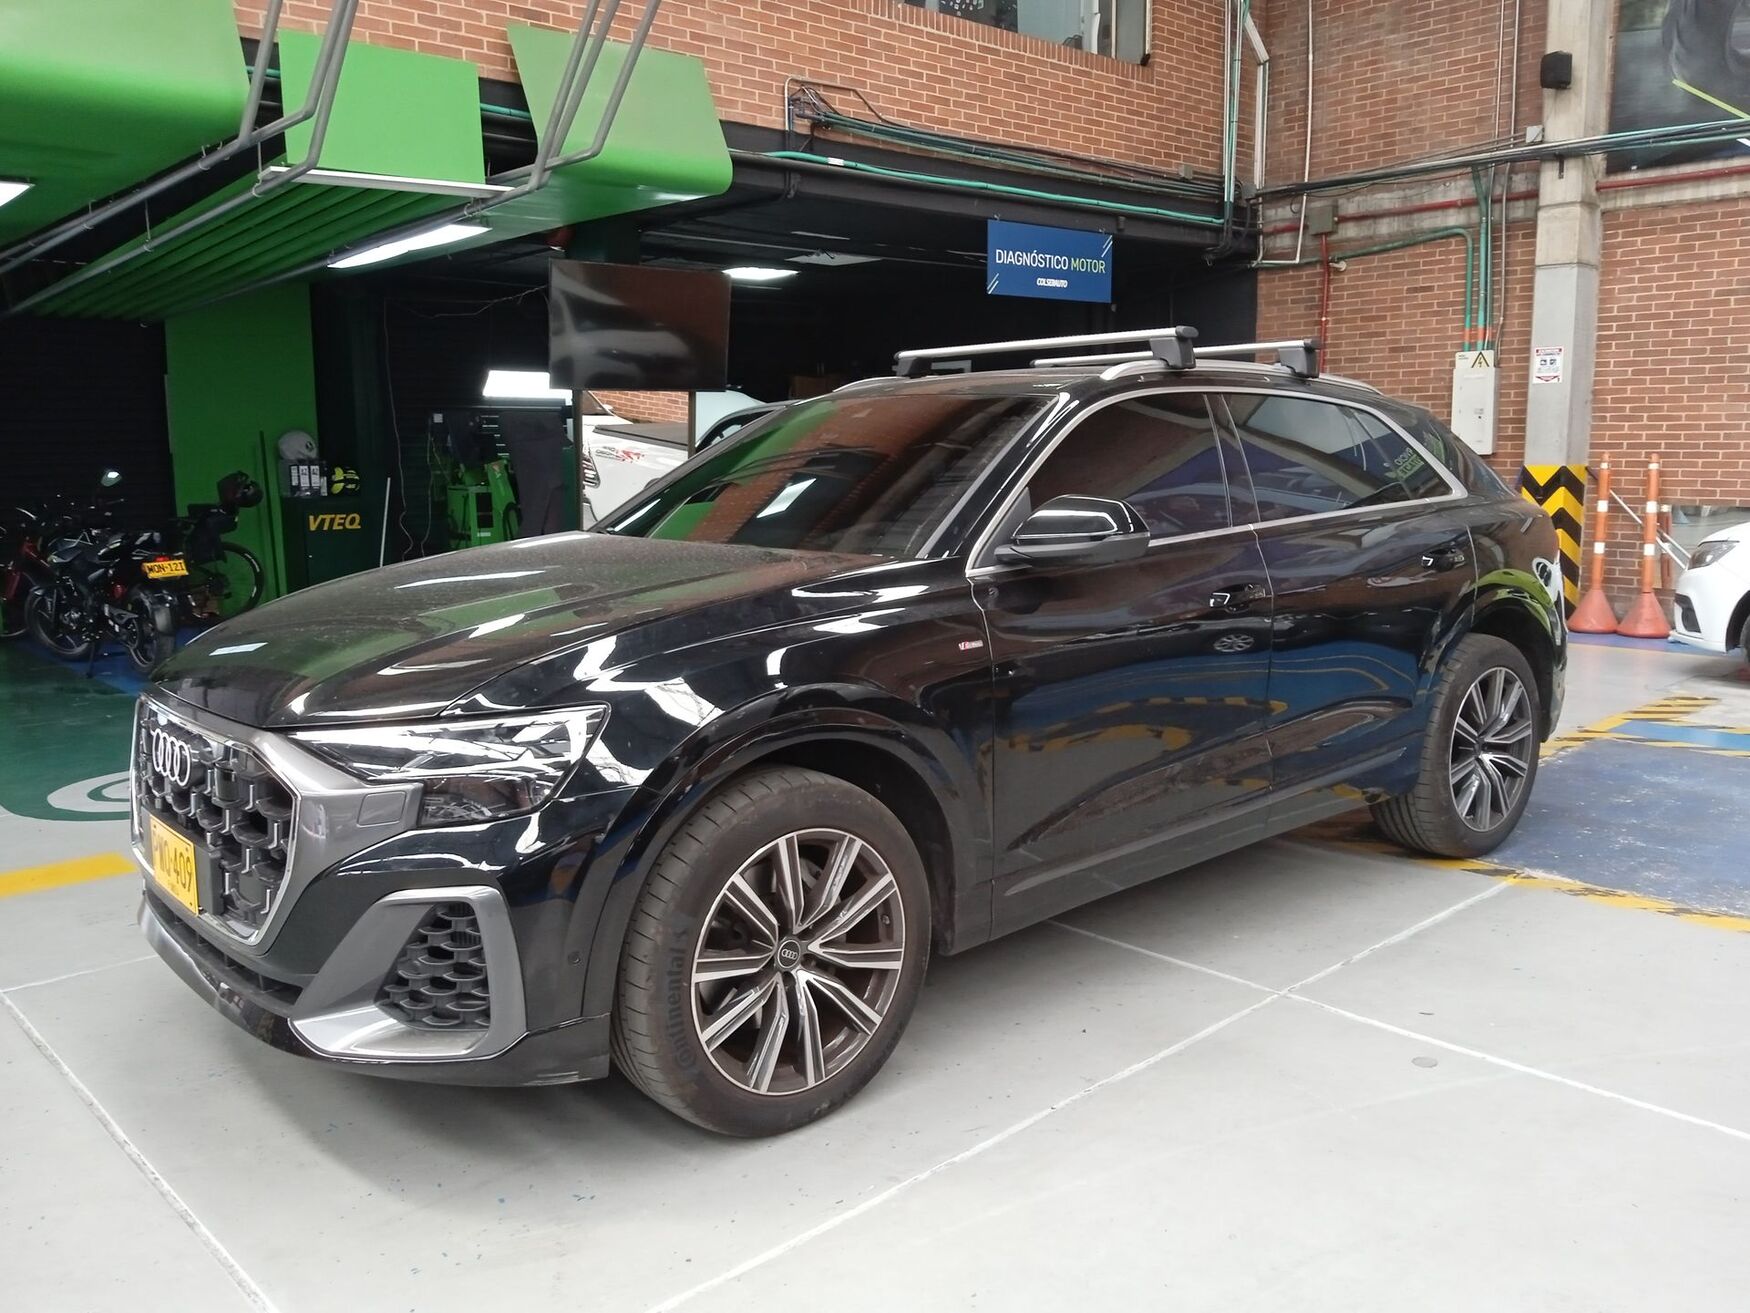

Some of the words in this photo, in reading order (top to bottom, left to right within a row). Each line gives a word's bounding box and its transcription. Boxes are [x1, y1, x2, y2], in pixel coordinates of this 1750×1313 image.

[995, 249, 1069, 270] DIAGNÓSTICO
[1071, 258, 1106, 274] MOTOR
[308, 513, 361, 531] VTEQ
